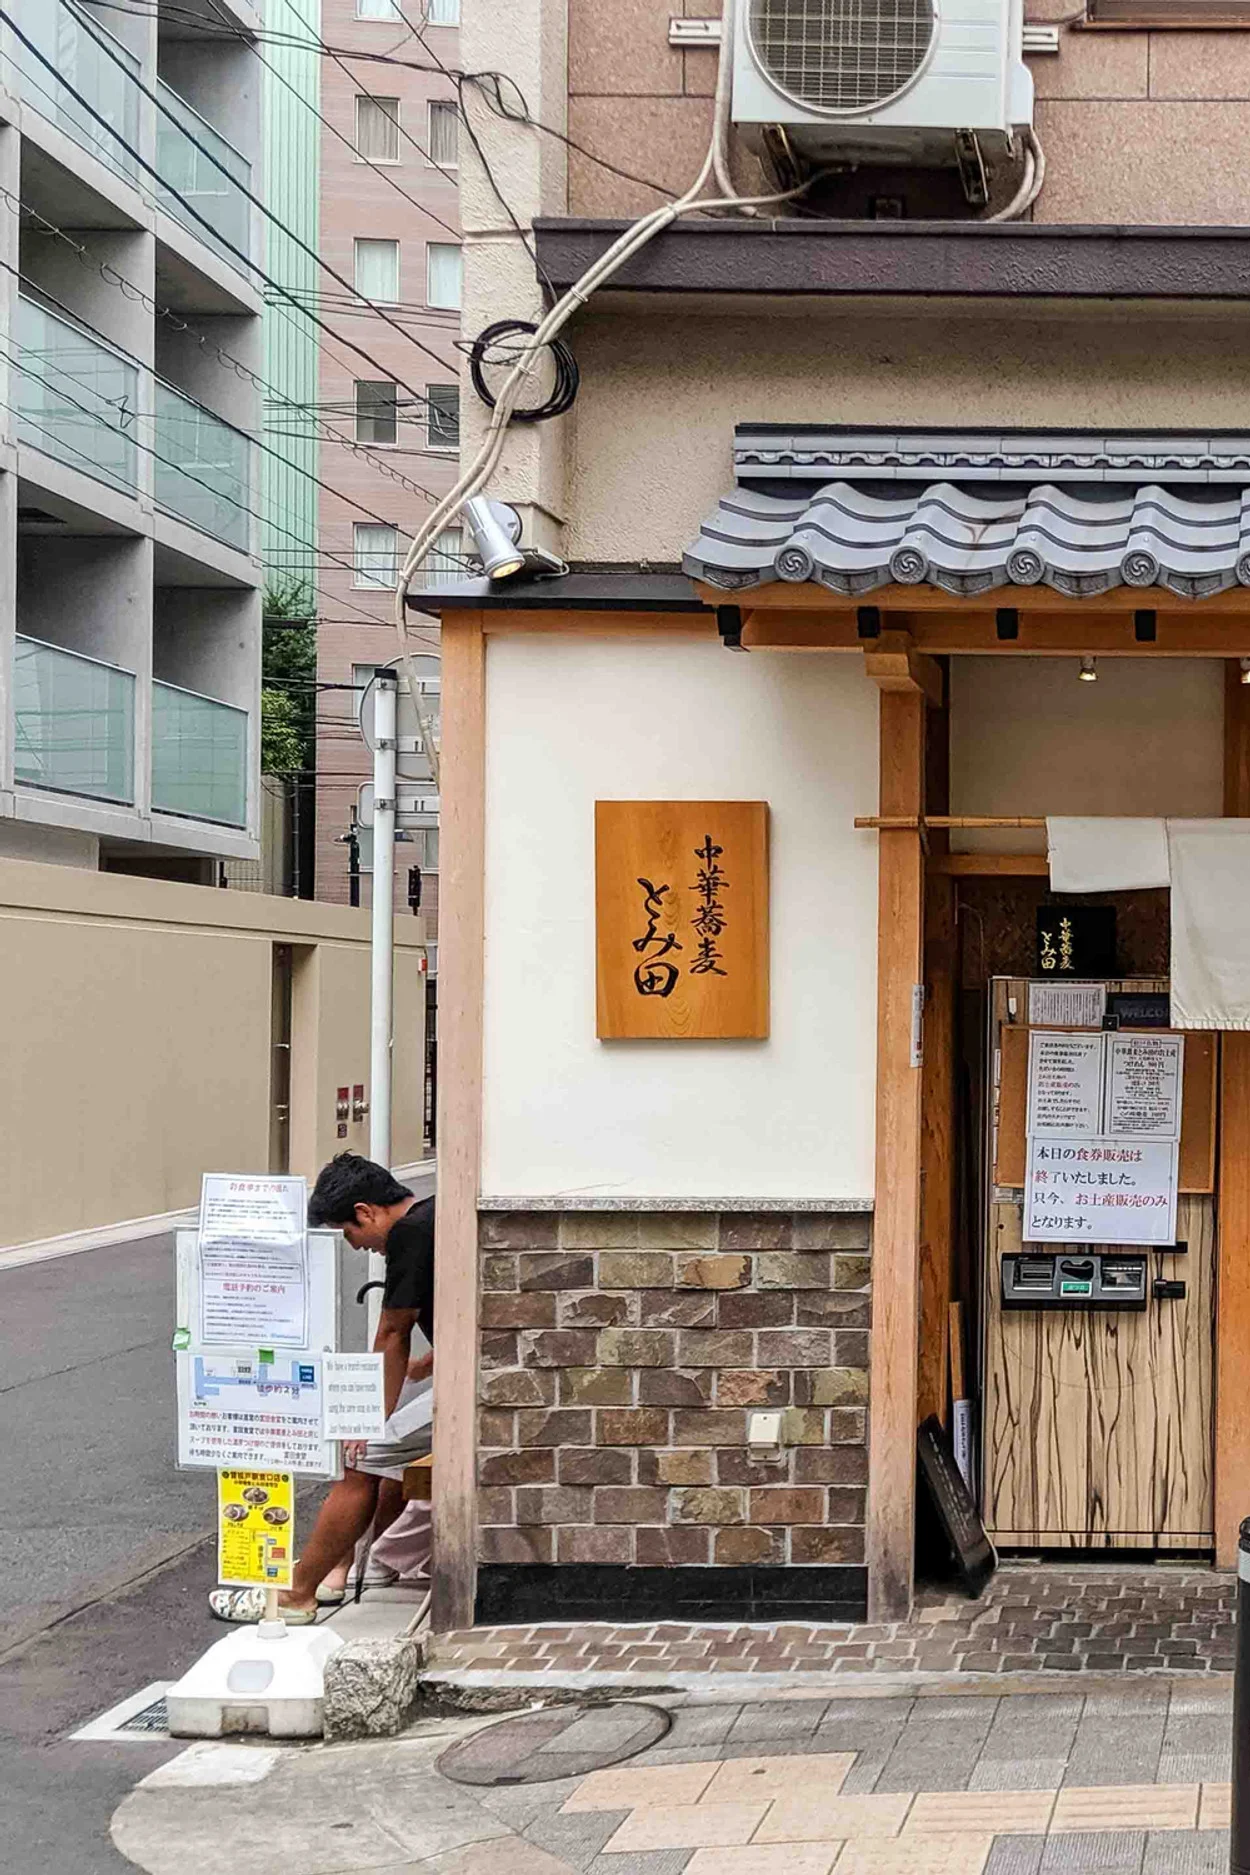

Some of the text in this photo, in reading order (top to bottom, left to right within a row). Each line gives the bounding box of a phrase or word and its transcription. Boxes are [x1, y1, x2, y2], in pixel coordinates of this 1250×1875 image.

[688, 834, 730, 976] 中華蕎麦
[632, 878, 683, 998] とみ田
[1040, 931, 1057, 969] とみ田
[1119, 1007, 1168, 1019] WELCO
[1037, 1146, 1143, 1163] 本日の食券販売は
[1034, 1170, 1137, 1186] 終了いたしました。
[1032, 1215, 1093, 1230] となります。
